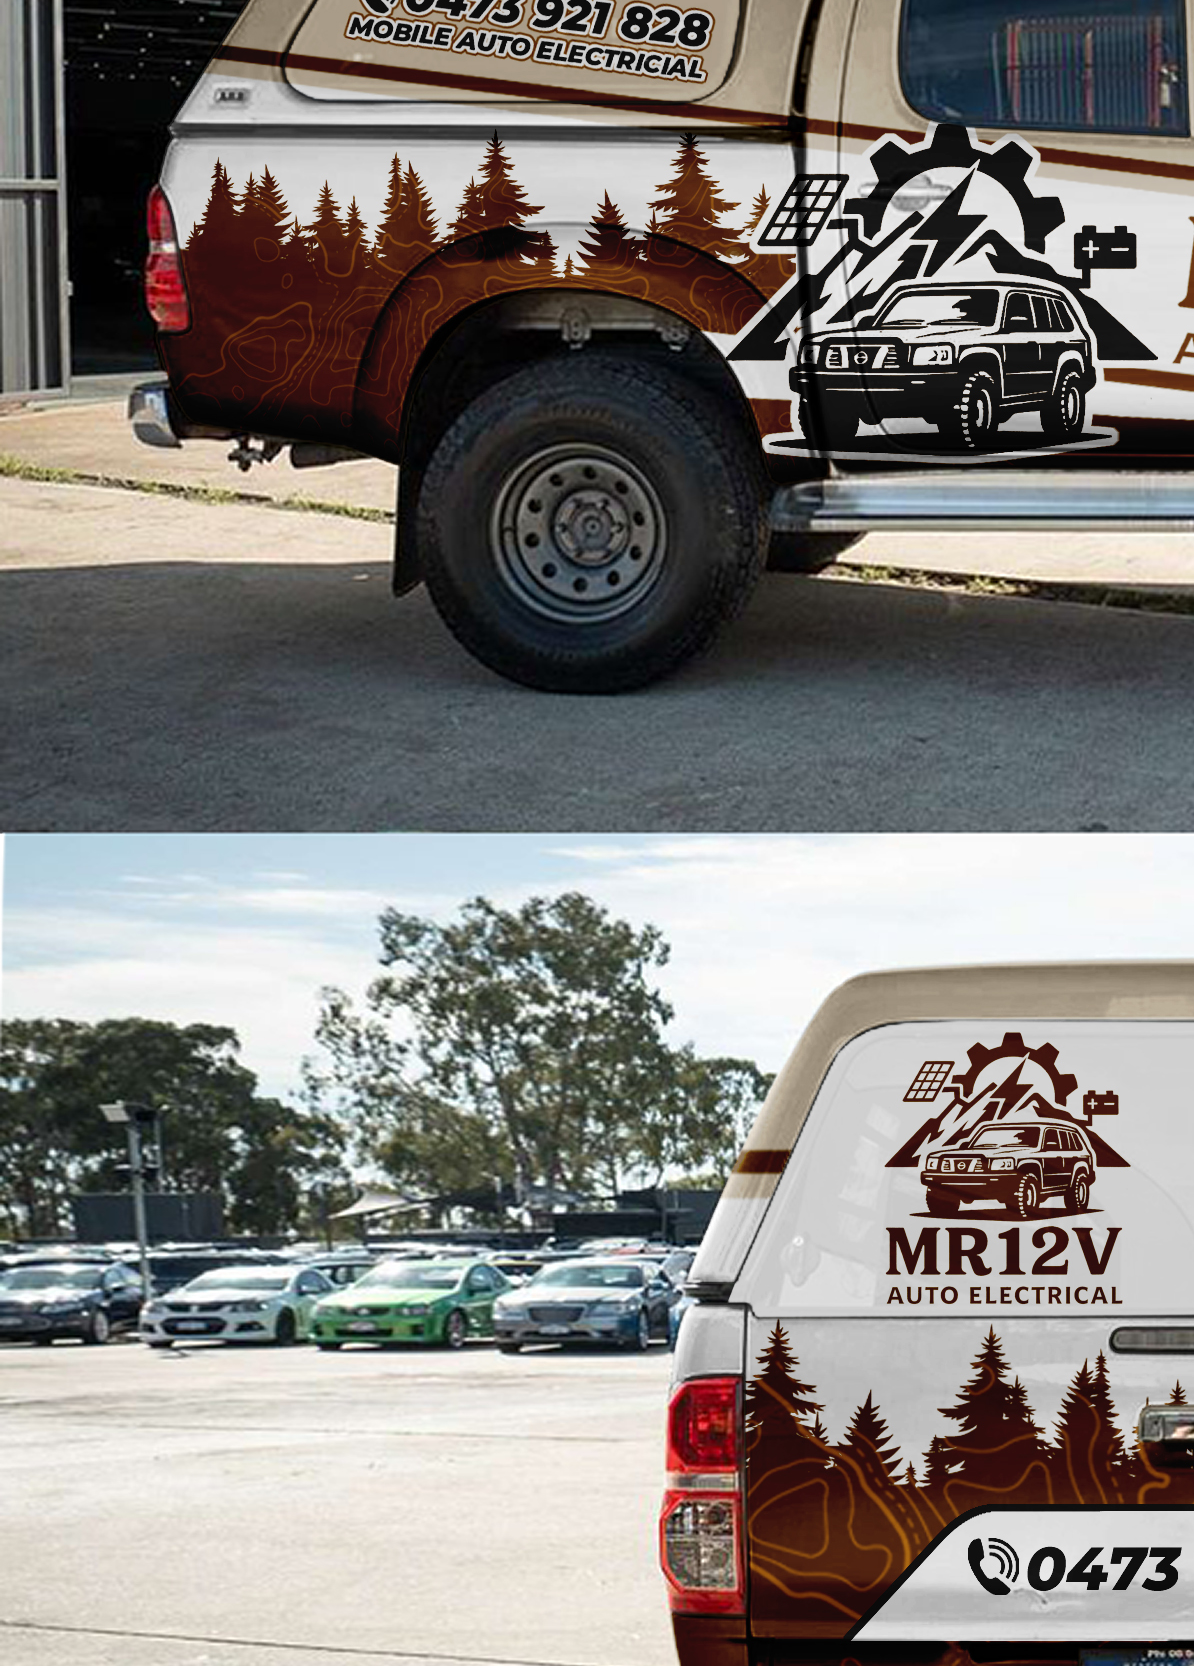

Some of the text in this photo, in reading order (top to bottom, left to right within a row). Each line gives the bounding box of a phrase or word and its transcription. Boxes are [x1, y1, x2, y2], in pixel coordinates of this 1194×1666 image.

[350, 17, 705, 79] MOBILE AUTO ELECTRICIAL
[620, 5, 711, 47] 828
[885, 1226, 1123, 1277] MR12V
[886, 1286, 1123, 1305] AUTO ELECTRICAL
[1026, 1545, 1183, 1592] 0473
